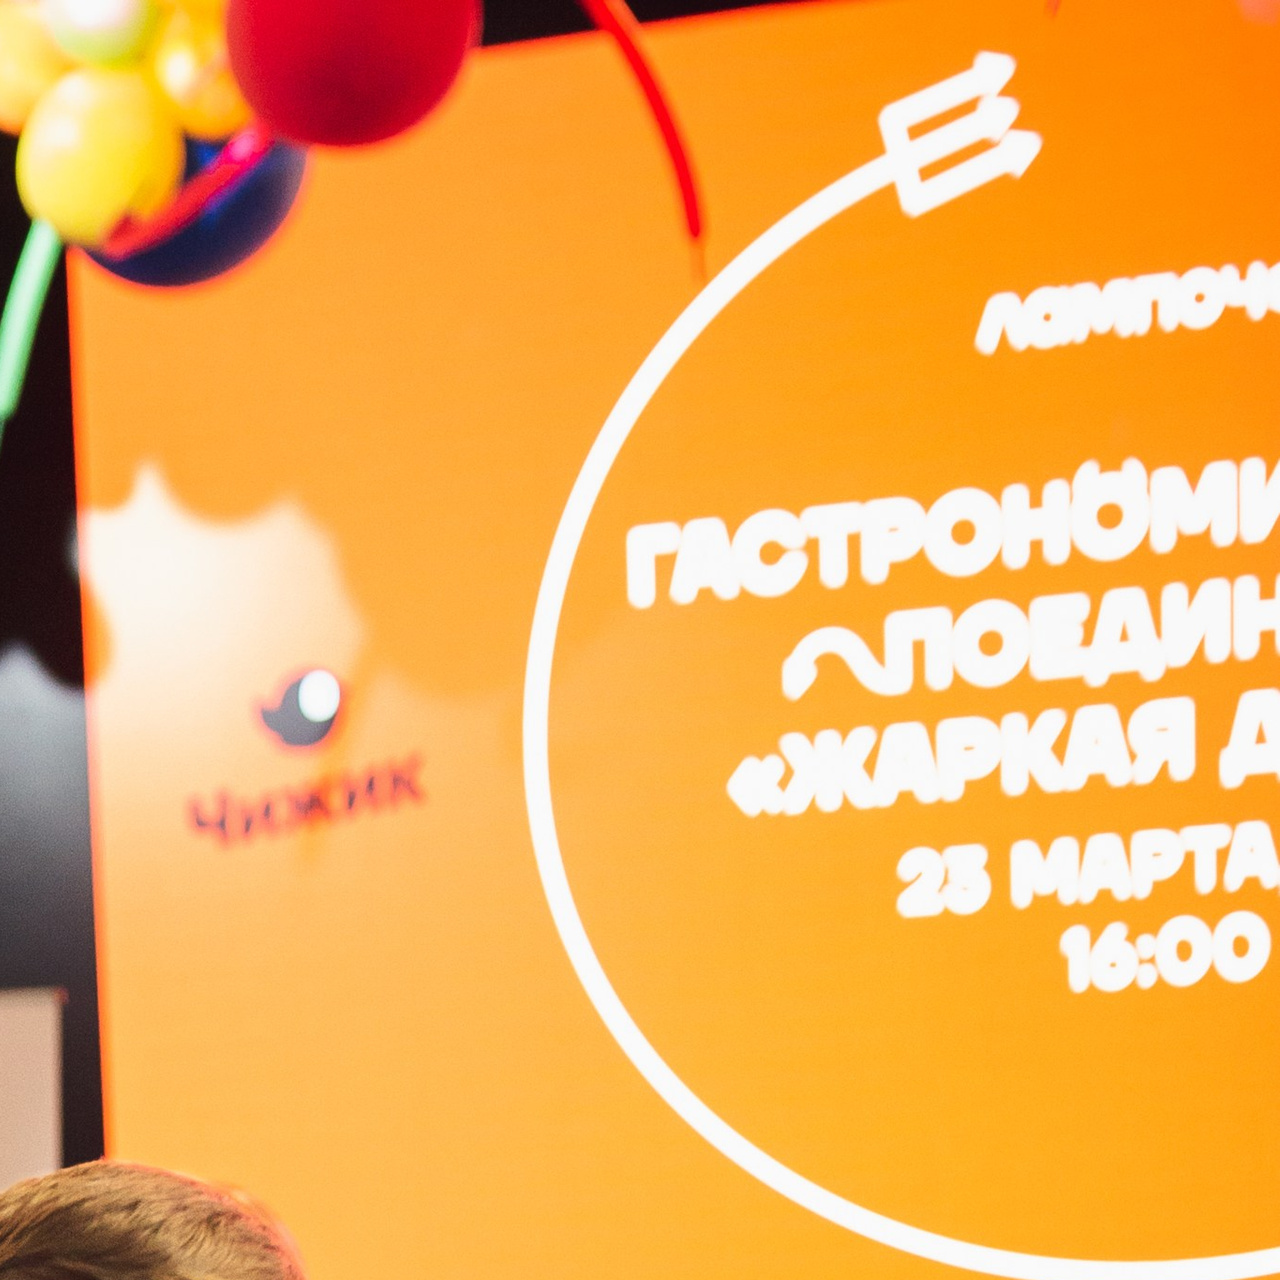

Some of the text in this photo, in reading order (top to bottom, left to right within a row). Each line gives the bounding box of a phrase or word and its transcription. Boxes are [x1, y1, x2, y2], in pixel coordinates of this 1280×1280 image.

[974, 260, 1280, 356] лампоч
[727, 697, 1196, 818] «ЖАРКАЯ
[1010, 821, 1280, 911] МАРТА
[1060, 911, 1272, 994] 16:00
